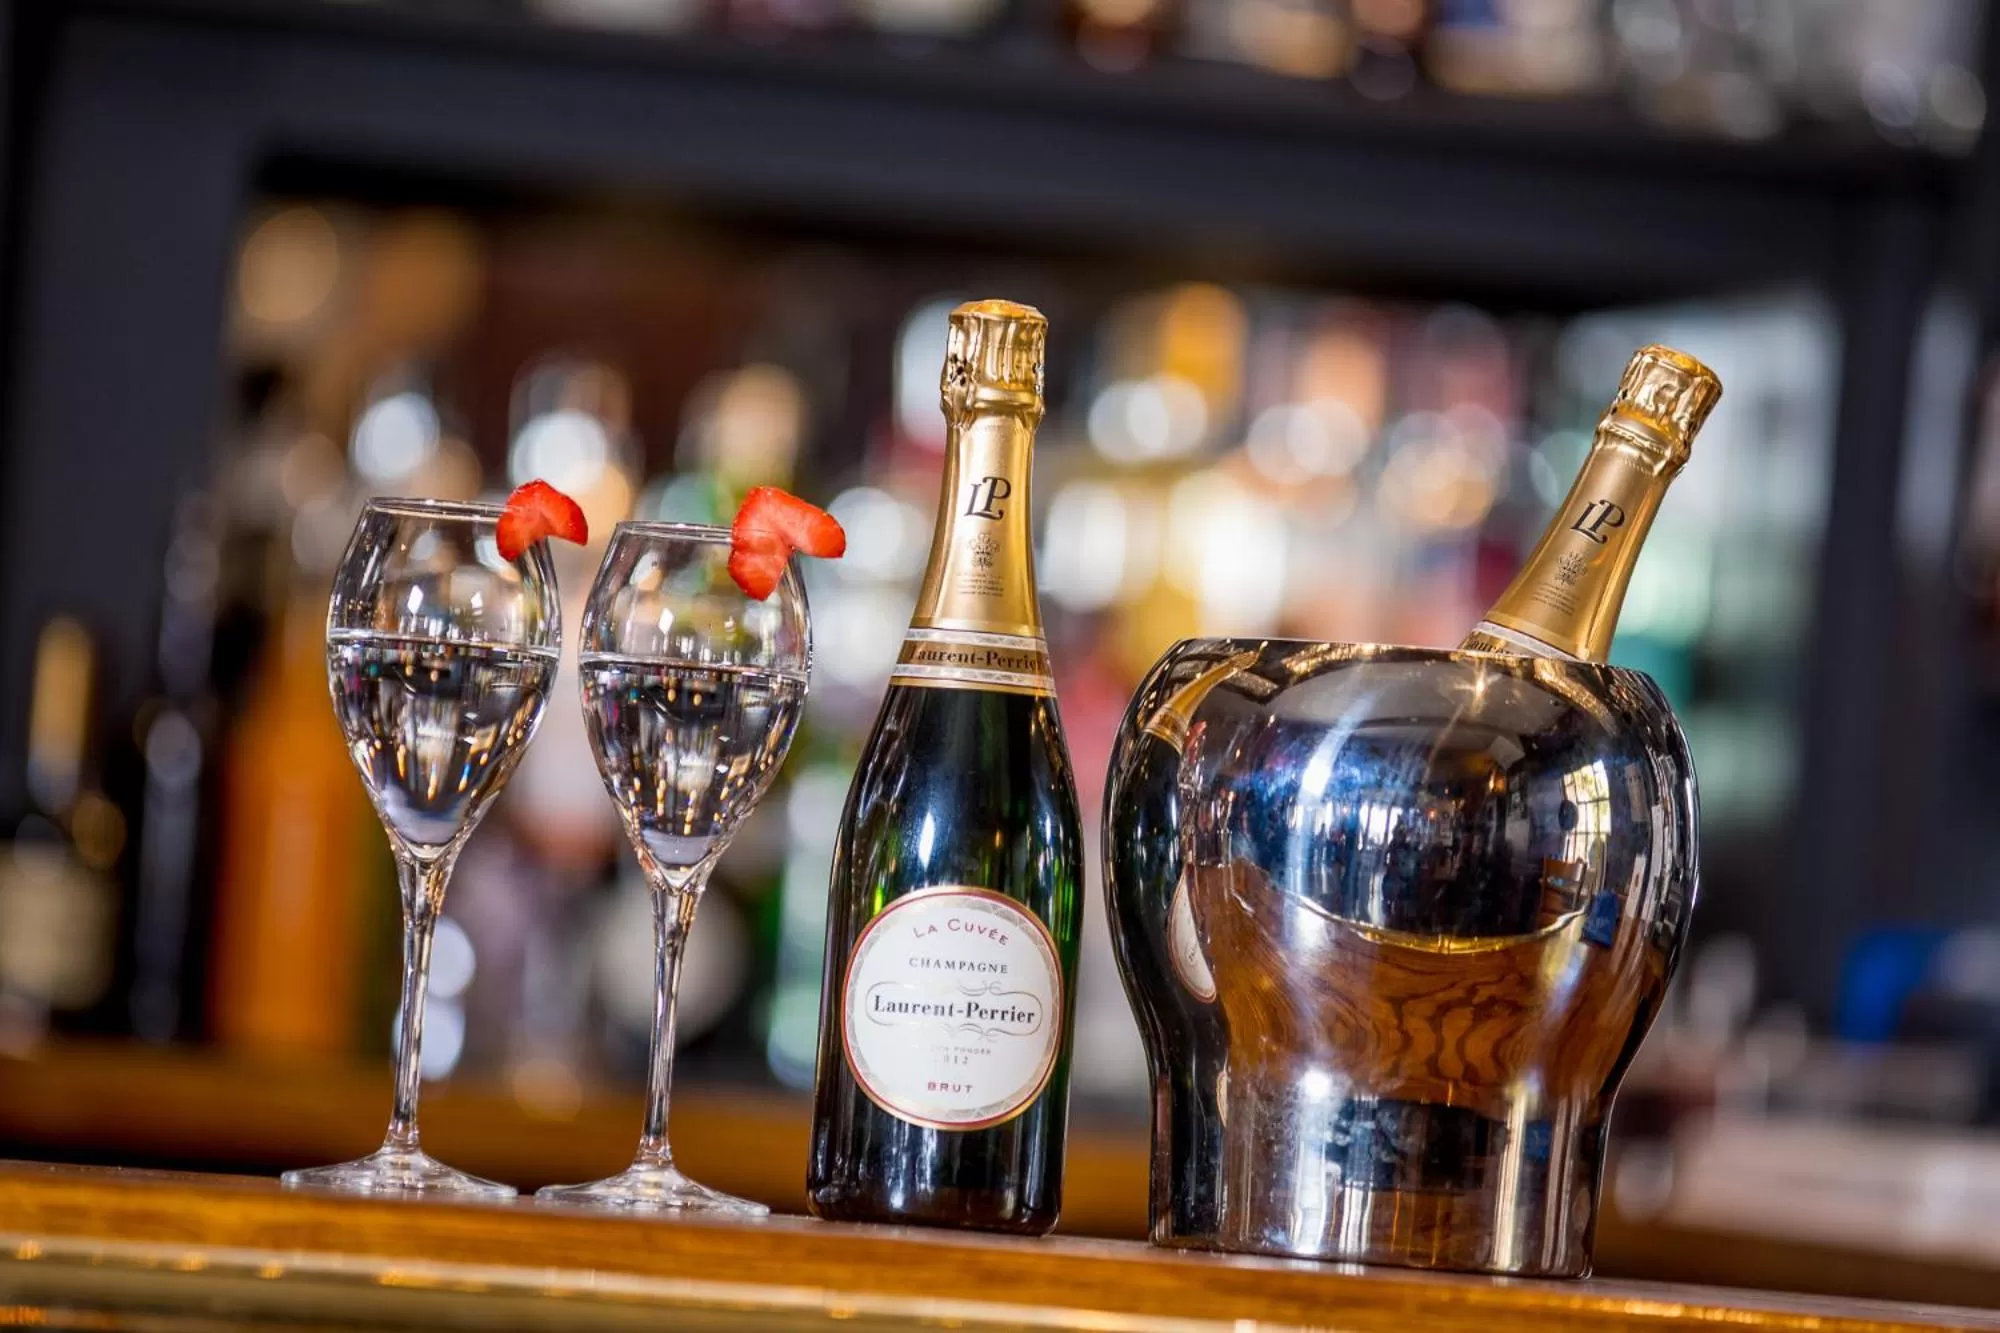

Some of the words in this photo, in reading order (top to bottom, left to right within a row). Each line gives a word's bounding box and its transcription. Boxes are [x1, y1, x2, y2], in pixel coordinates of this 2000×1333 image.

[963, 476, 1012, 520] LP
[1570, 499, 1625, 545] LP
[909, 957, 1009, 974] CHAMPAGNE
[874, 994, 1036, 1024] Laurent-Perrier
[927, 1081, 973, 1093] BRUT
